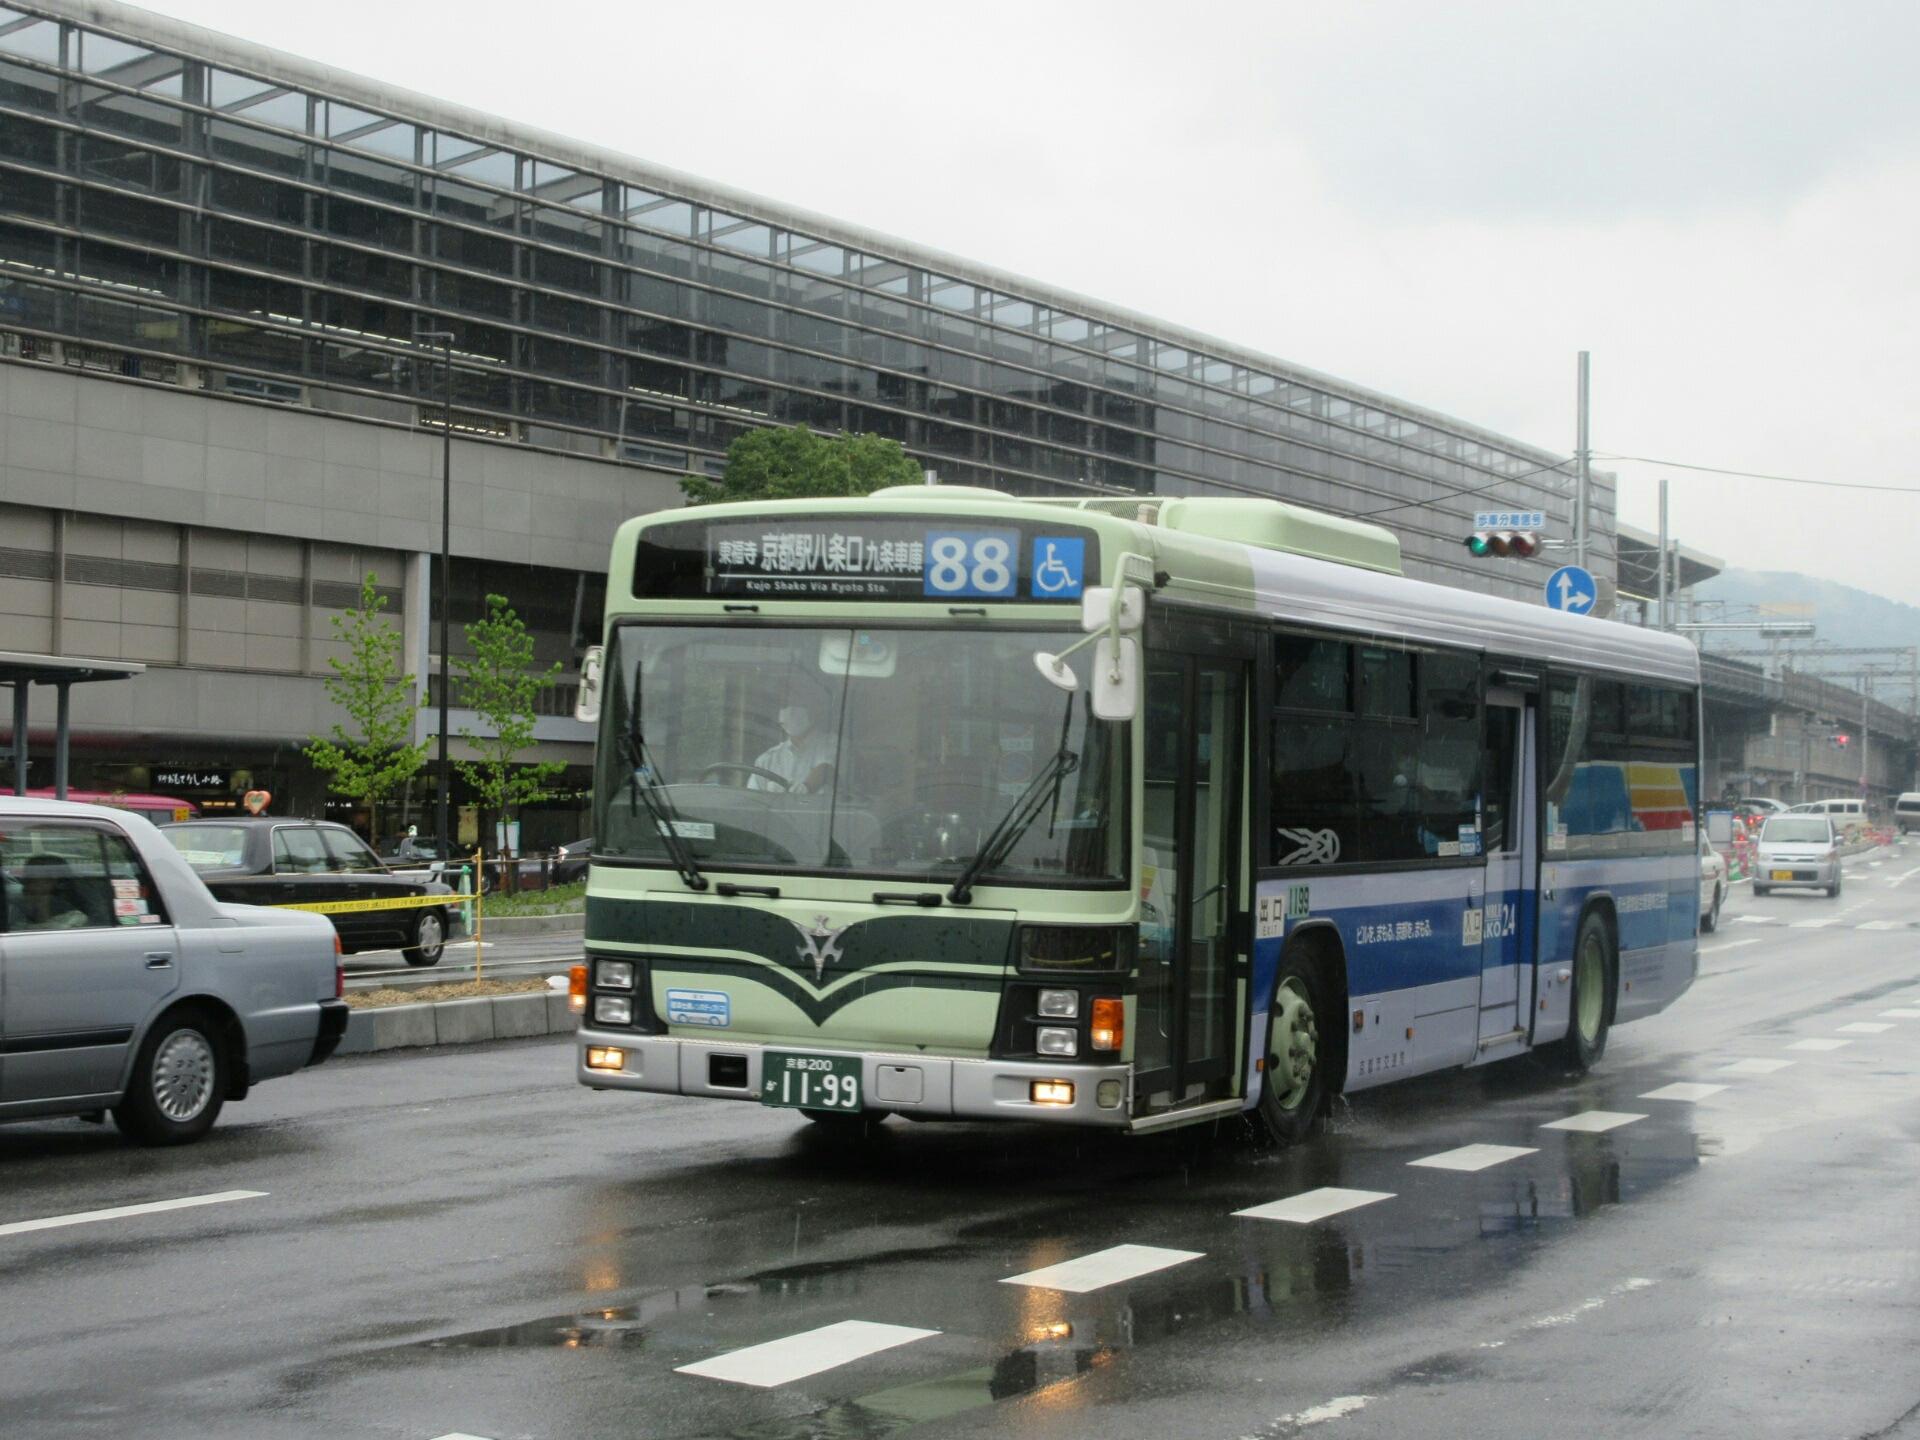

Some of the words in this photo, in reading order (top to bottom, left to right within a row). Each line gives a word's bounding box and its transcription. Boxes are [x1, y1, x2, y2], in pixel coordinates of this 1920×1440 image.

[1477, 513, 1544, 528] 歩車分離信号
[718, 540, 758, 565] 東福寺
[760, 533, 864, 573] 京都駅八条口
[865, 540, 924, 573] 九条車庫
[930, 537, 1011, 593] 88
[774, 581, 807, 592] Shako
[810, 582, 829, 592] Via
[831, 583, 864, 594] Kyoto
[1260, 899, 1282, 922] 出口
[1289, 887, 1310, 915] 1199
[1465, 912, 1481, 932] 入口
[1502, 903, 1516, 937] 24
[783, 1071, 857, 1107] 11-99
